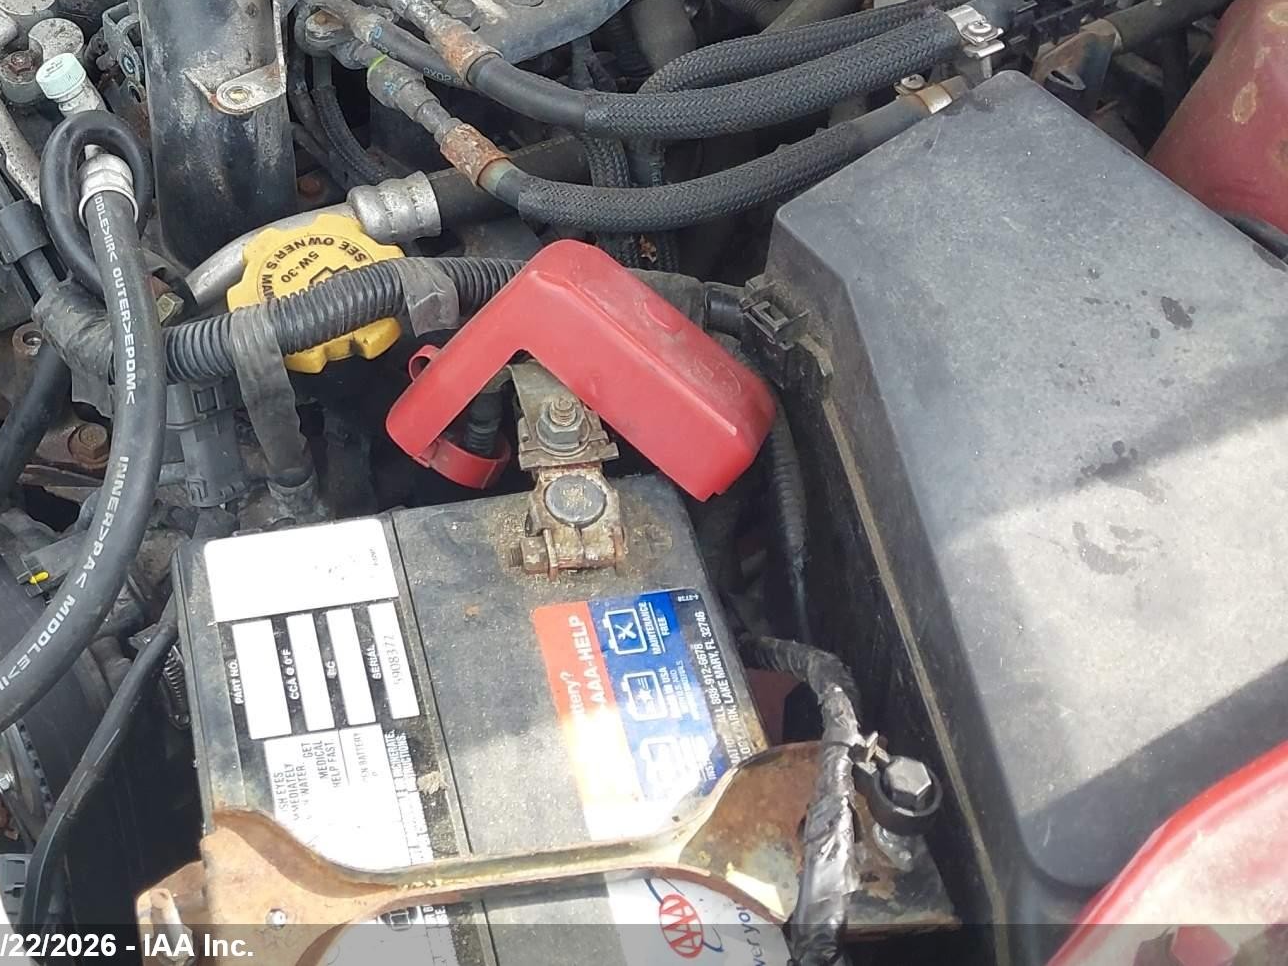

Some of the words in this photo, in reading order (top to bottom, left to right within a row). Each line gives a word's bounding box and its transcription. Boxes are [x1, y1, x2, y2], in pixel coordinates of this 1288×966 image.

[94, 194, 118, 263] DDLE>IIR<
[265, 236, 335, 270] OWNER'S
[338, 240, 369, 263] SEE
[280, 250, 320, 283] 5W-30
[76, 456, 129, 589] INNER>PA<
[639, 602, 661, 655] MAINTENANCE
[658, 616, 670, 635] FREE
[705, 639, 716, 650] FL
[229, 658, 240, 678] NO.
[367, 645, 381, 680] SERIAL
[659, 667, 670, 683] USA
[693, 643, 721, 705] 888-912-6678
[709, 651, 726, 679] MARY,
[233, 679, 244, 704] PART
[289, 678, 299, 700] CCA
[719, 679, 733, 704] LAKE
[302, 742, 312, 758] GET
[314, 741, 328, 779] MEDICAL
[275, 772, 285, 796] EYES
[330, 765, 341, 787] HELP
[659, 895, 703, 958] AAA
